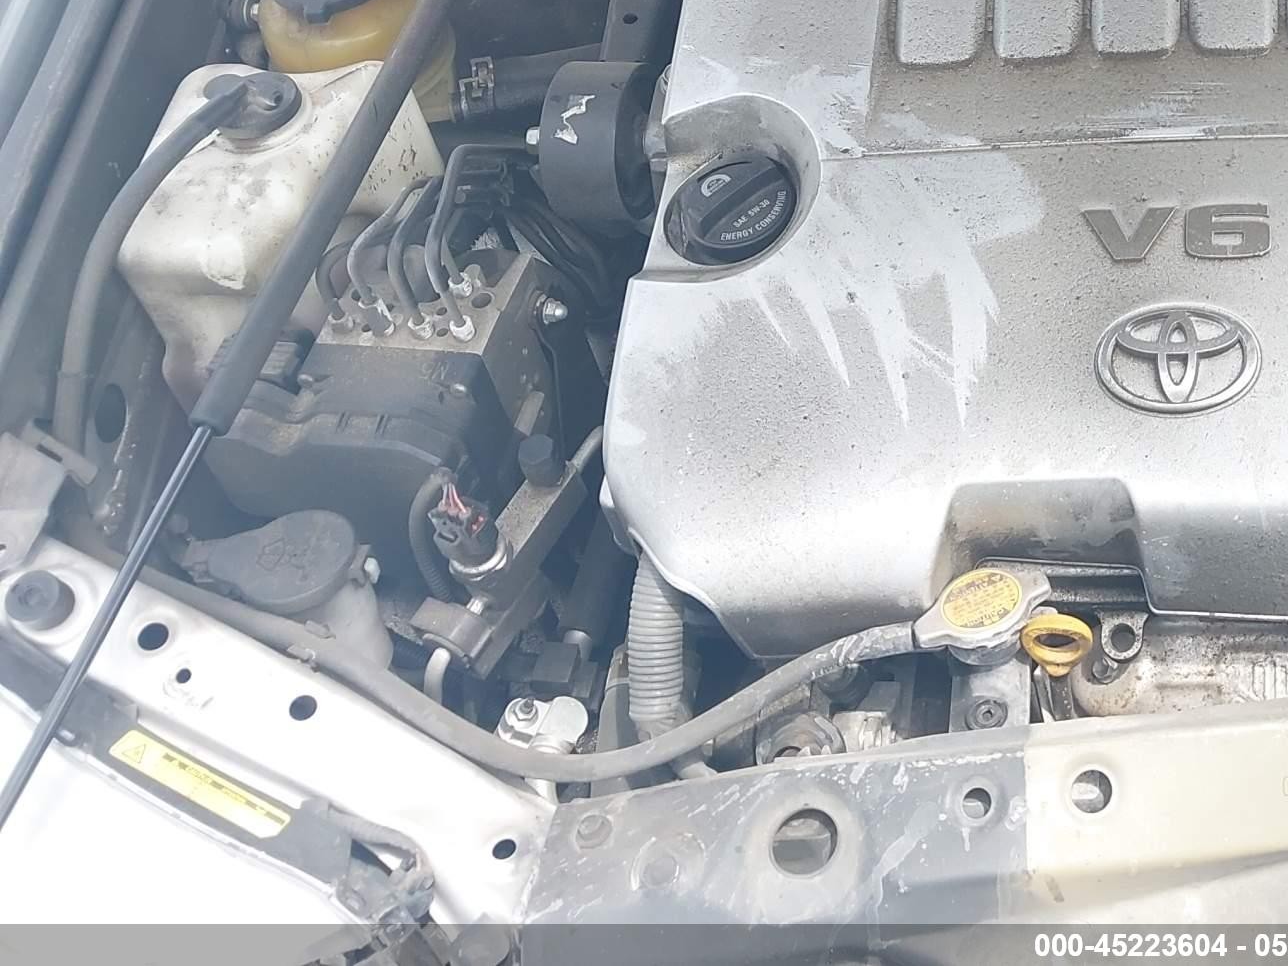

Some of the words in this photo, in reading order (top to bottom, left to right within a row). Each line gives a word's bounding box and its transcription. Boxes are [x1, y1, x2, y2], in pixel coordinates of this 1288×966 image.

[720, 227, 753, 240] ENERGY
[756, 191, 786, 230] CONSERVING
[733, 216, 748, 228] SAE
[749, 199, 770, 216] 5W-30
[1082, 202, 1273, 261] V6
